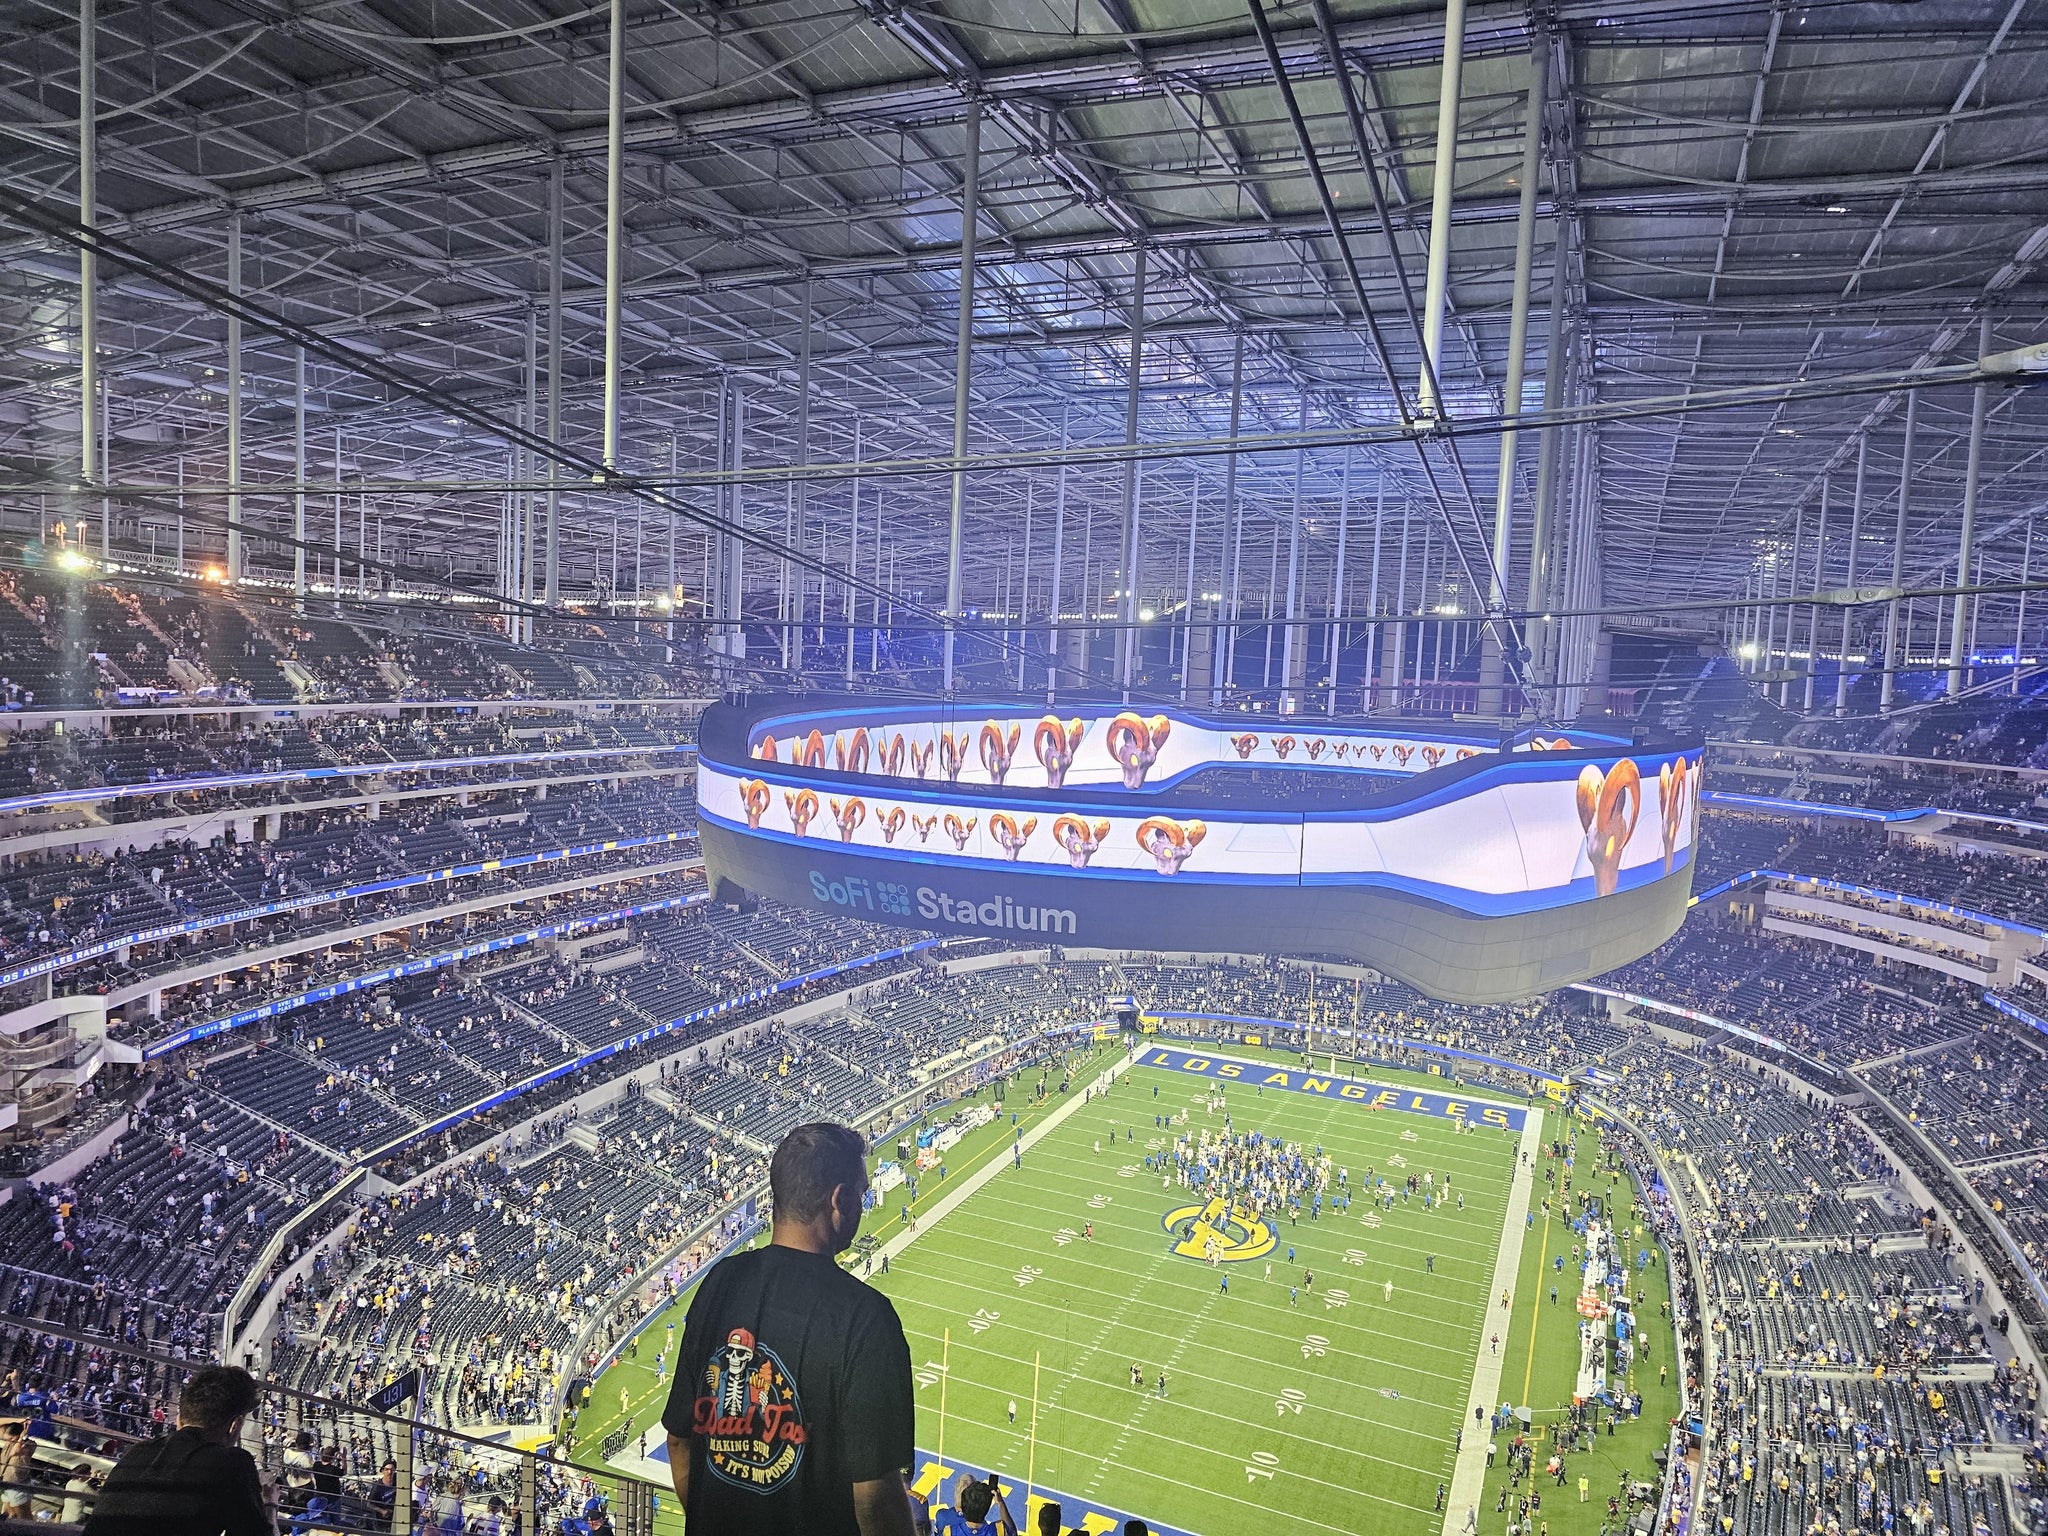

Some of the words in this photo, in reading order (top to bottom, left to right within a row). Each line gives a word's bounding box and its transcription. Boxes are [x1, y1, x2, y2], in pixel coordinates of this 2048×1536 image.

[808, 870, 874, 910] SoFi
[916, 887, 1077, 934] Stadium
[23, 954, 74, 977] ANGELES
[76, 944, 104, 960] RAMS
[138, 924, 185, 941] SEASON
[196, 917, 221, 928] SOFI
[335, 890, 348, 899] CA
[614, 1022, 673, 1052] WORLD
[684, 985, 778, 1023] CHAMPIONS
[1152, 1053, 1245, 1078] LOS
[1263, 1072, 1509, 1124] ANGELES
[1087, 1194, 1113, 1208] 50
[1052, 1227, 1079, 1243] 40
[1342, 1249, 1367, 1266] 50
[1013, 1265, 1043, 1284] 30
[1324, 1289, 1350, 1308] 40
[967, 1307, 1000, 1330] 20
[1301, 1335, 1330, 1357] 30
[914, 1360, 950, 1384] 10
[383, 1383, 403, 1405] 431
[1275, 1388, 1307, 1415] 20
[692, 1397, 757, 1436] Dad
[709, 1437, 750, 1452] MAKING
[725, 1460, 749, 1479] IT'S
[765, 1444, 797, 1483] POISON
[1245, 1451, 1280, 1481] 10
